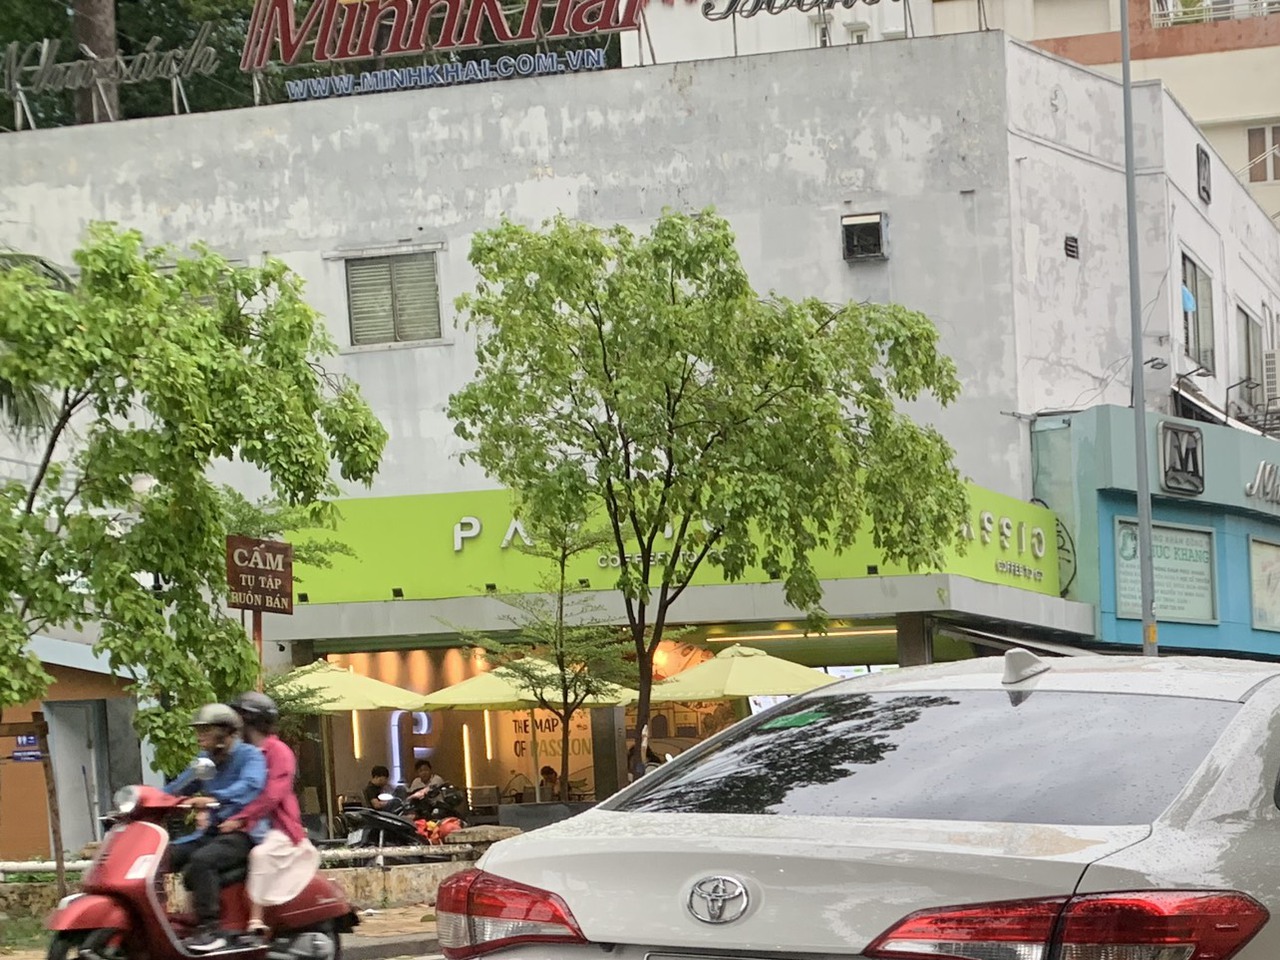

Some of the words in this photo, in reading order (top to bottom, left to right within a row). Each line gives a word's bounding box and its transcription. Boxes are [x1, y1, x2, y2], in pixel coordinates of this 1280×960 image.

[285, 48, 606, 100] WWW.MINHKHAI.COM.VN
[233, 544, 284, 571] CẤM
[240, 574, 255, 590] TỤ
[259, 575, 282, 592] TẬP
[265, 593, 288, 609] BÁN
[512, 720, 530, 734] THE
[534, 718, 559, 733] MAP
[514, 740, 526, 757] OF
